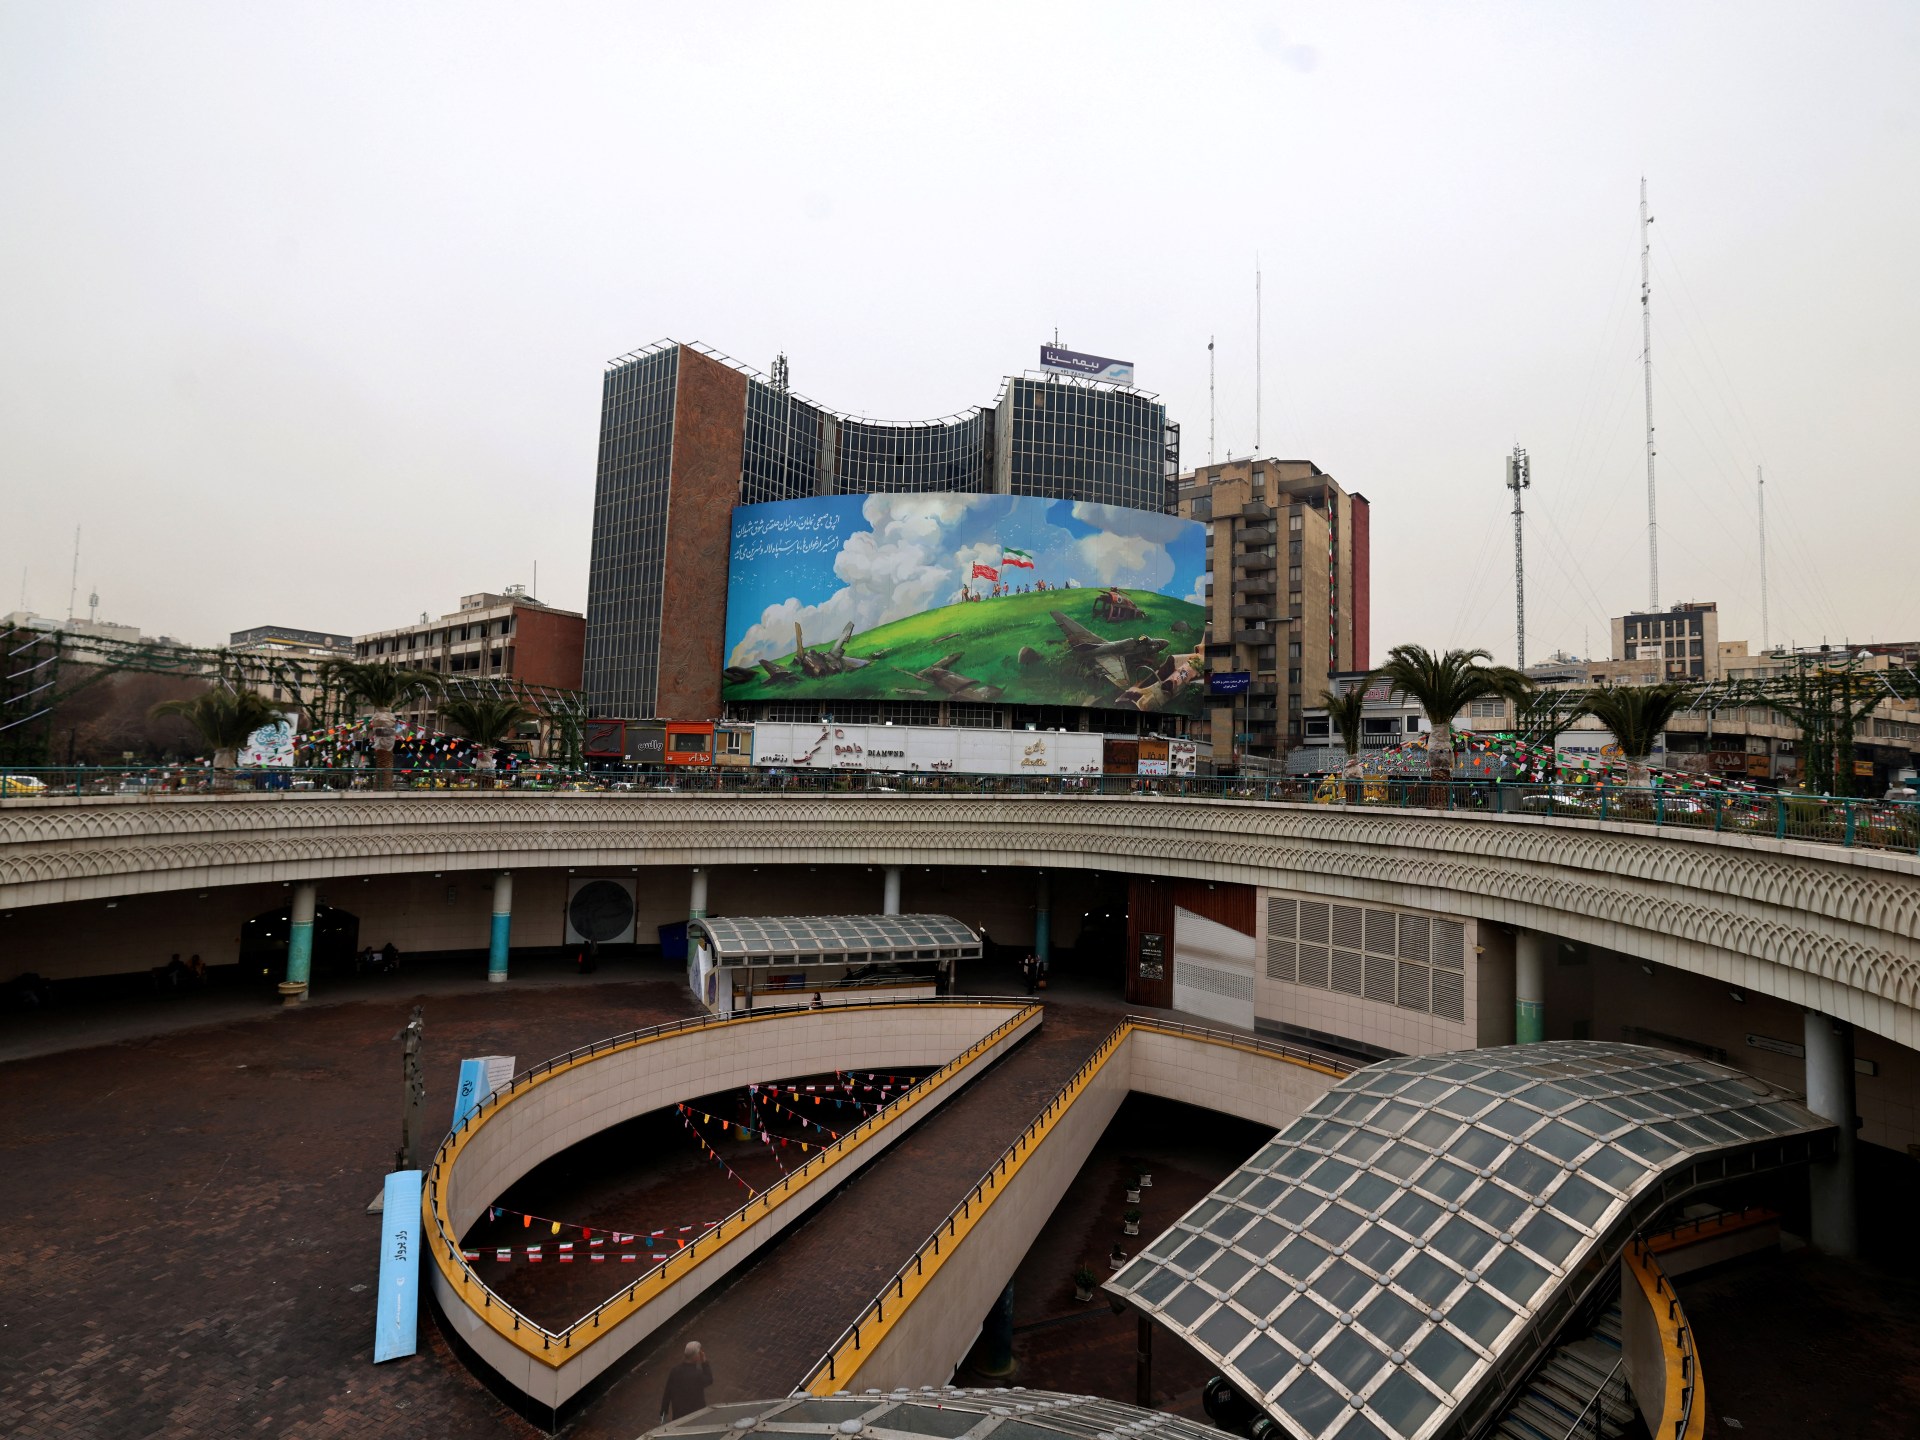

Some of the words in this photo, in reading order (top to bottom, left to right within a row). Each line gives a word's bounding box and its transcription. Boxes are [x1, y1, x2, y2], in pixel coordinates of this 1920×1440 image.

[1046, 351, 1071, 364] سینا
[1072, 358, 1099, 371] بیمه
[395, 1230, 407, 1241] راز
